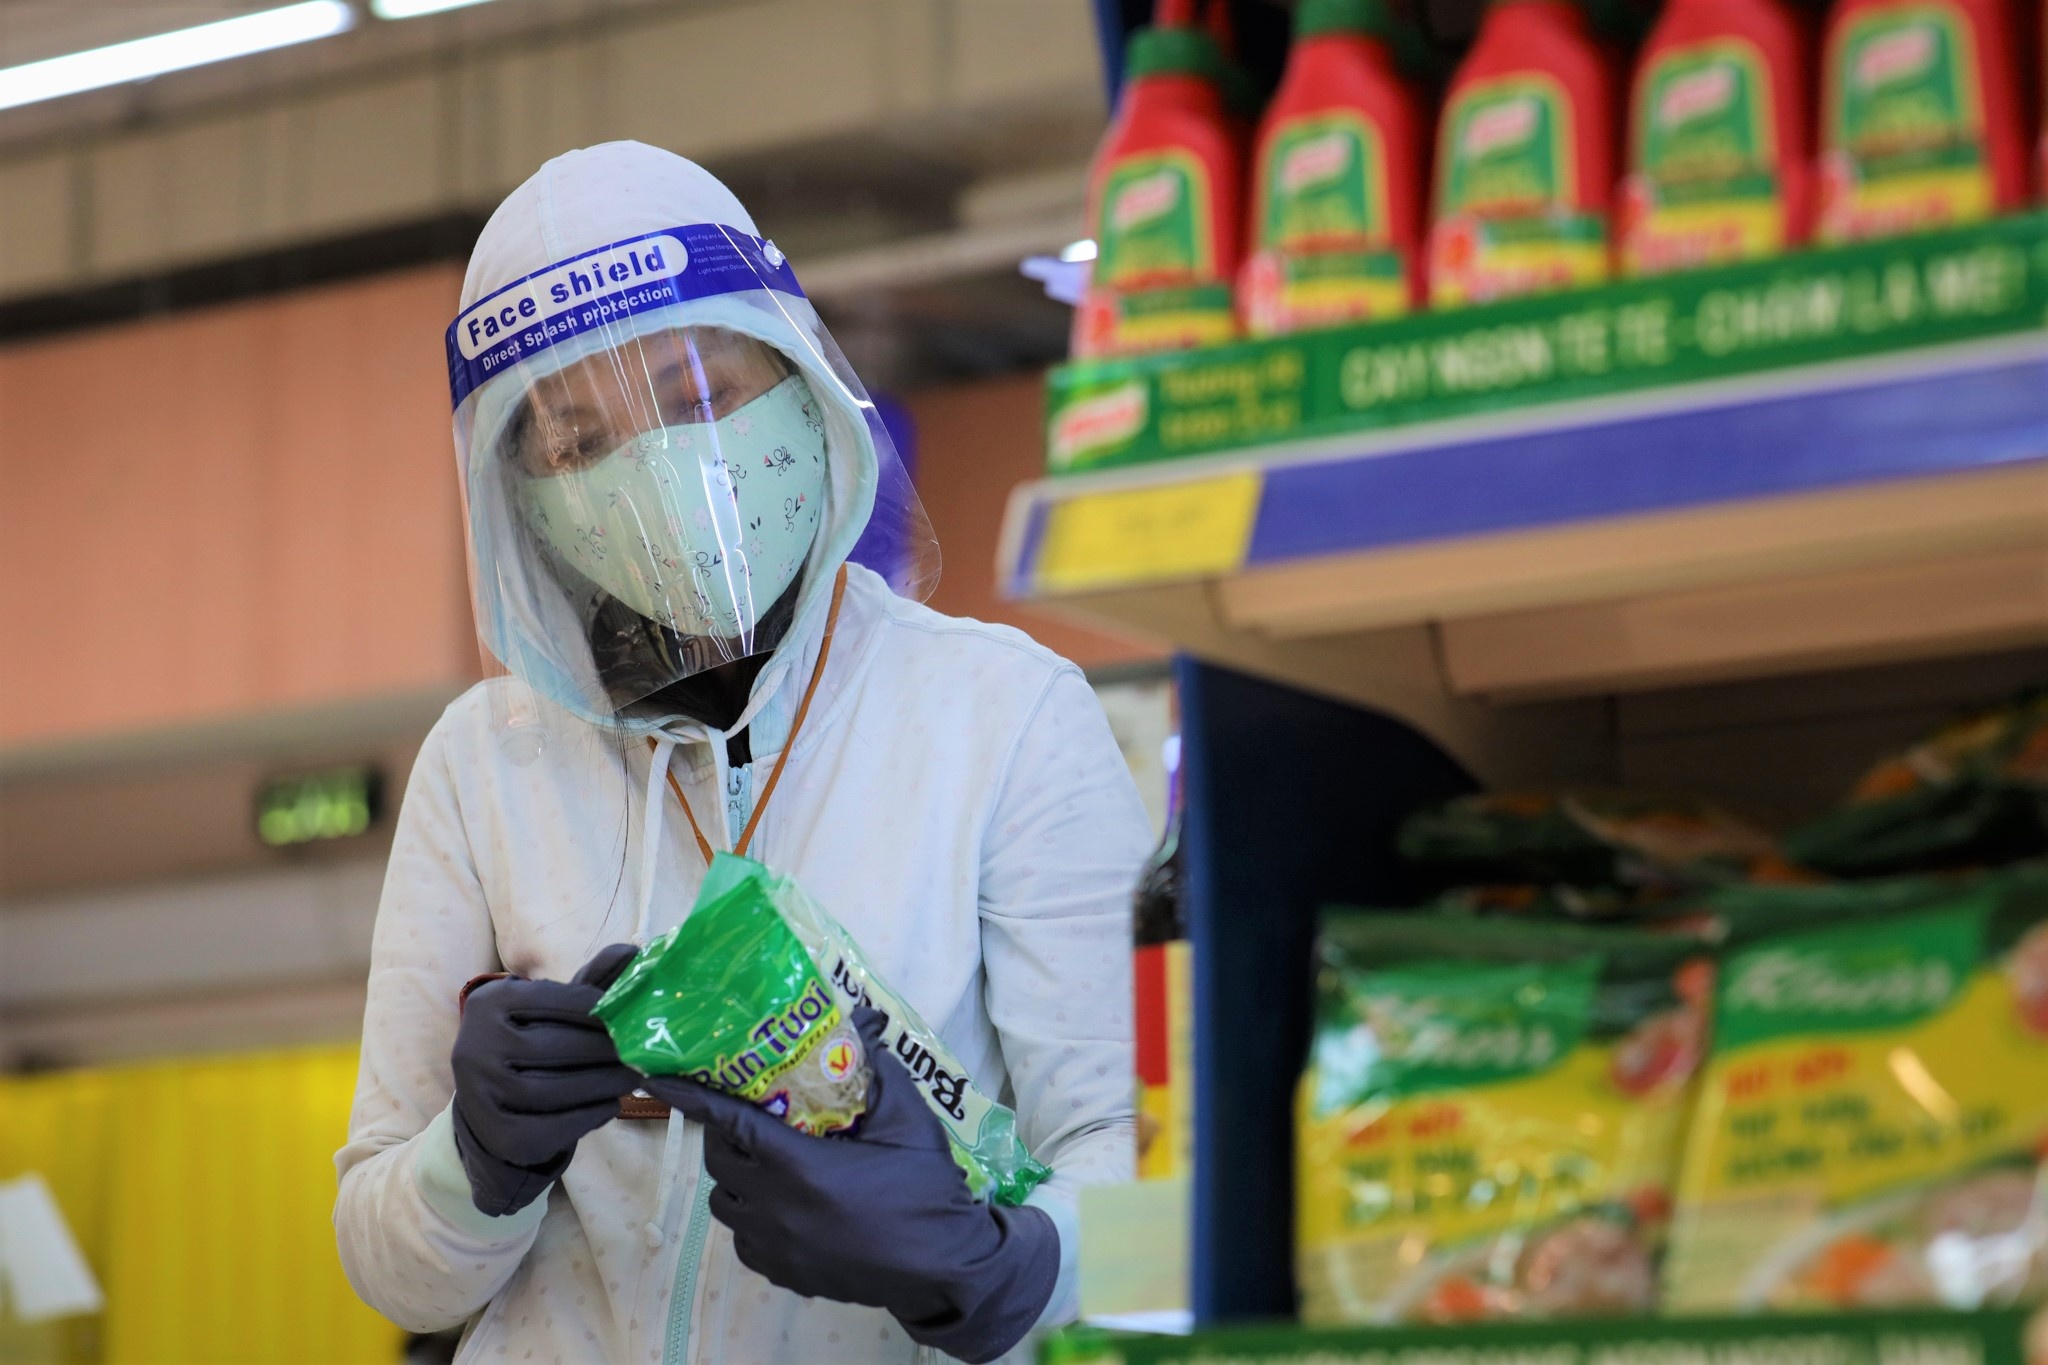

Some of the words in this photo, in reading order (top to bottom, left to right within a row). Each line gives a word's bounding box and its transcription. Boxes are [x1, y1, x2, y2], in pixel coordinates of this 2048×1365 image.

[467, 297, 537, 347] Face
[550, 245, 666, 303] shield
[482, 339, 522, 371] Direct
[524, 315, 578, 346] Splash
[582, 286, 673, 325] protection
[896, 1030, 969, 1121] Bún
